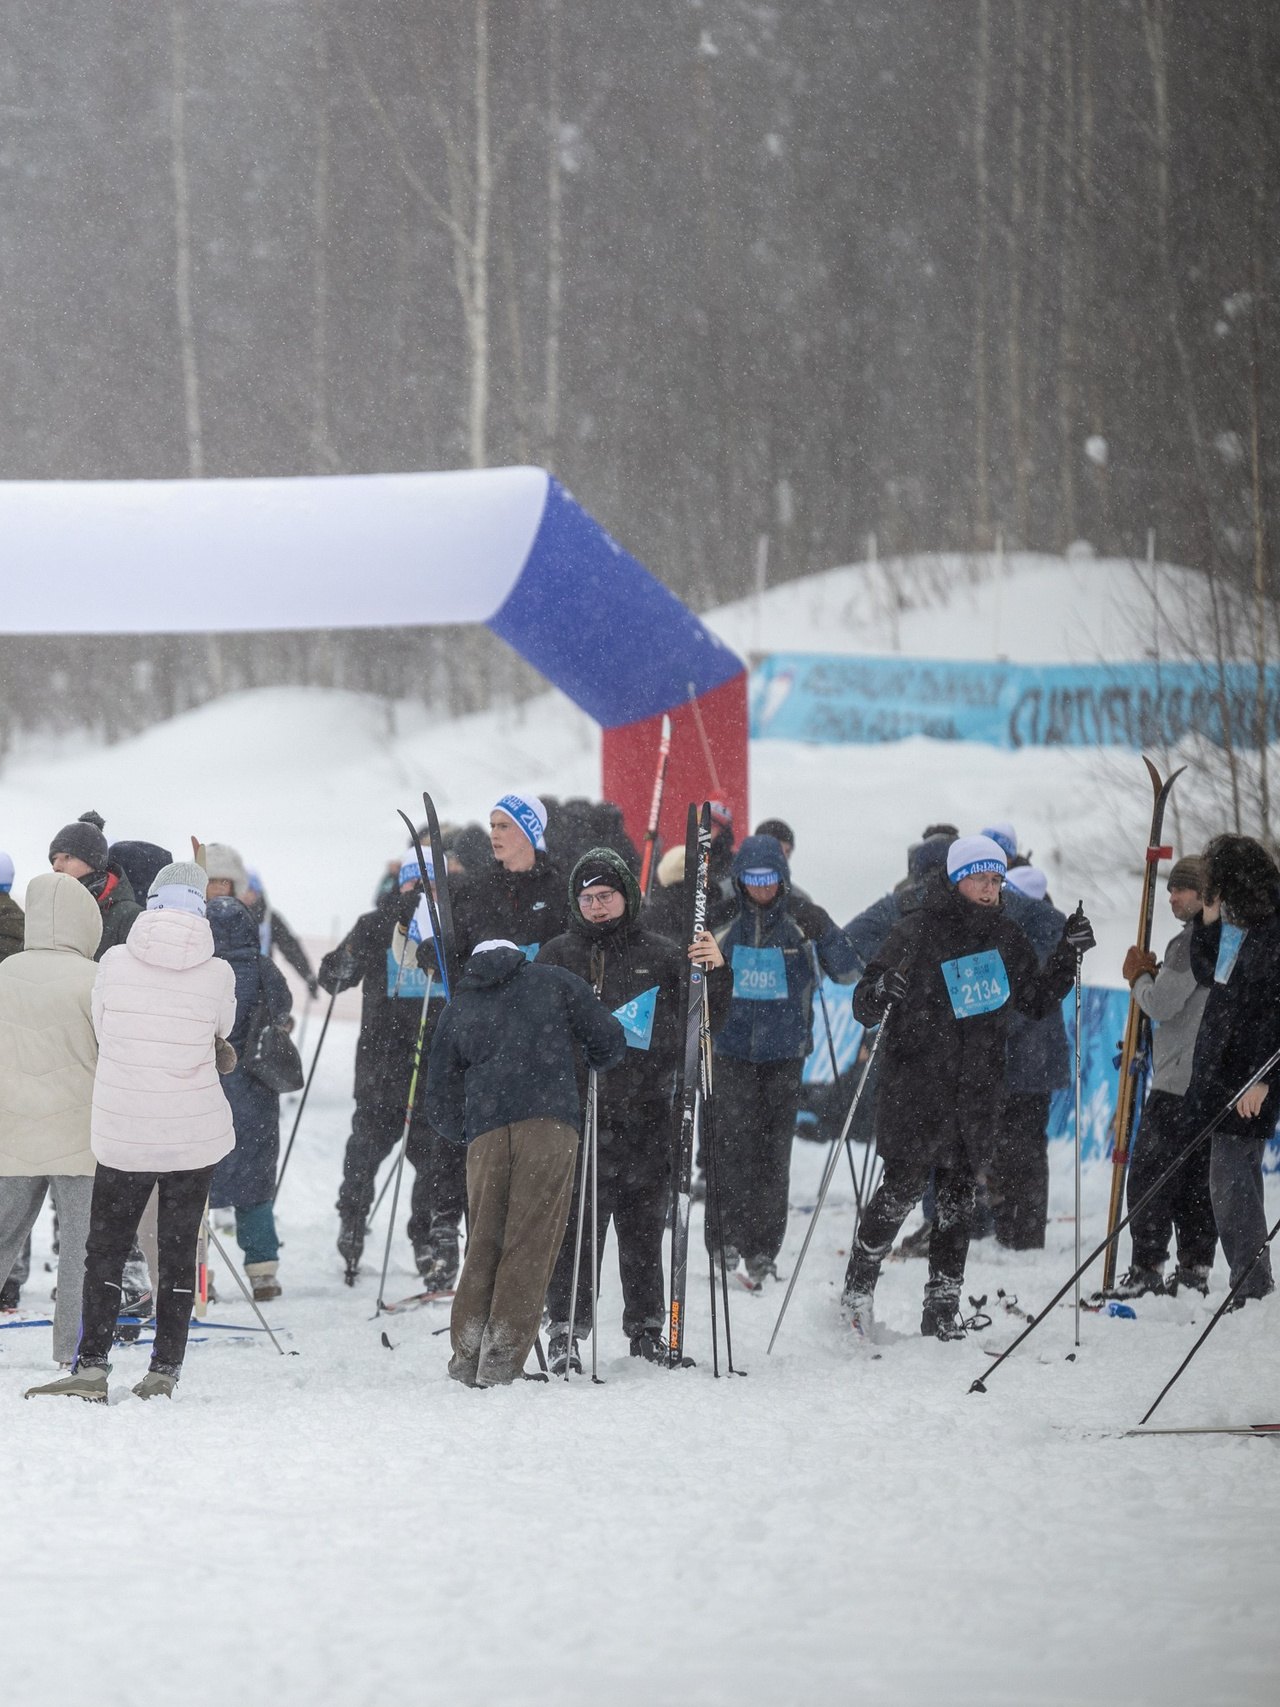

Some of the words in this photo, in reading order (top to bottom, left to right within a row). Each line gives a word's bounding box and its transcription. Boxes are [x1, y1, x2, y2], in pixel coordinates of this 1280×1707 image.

[520, 809, 543, 842] 202
[961, 977, 1001, 1005] 2134
[671, 1301, 680, 1325] COMBI
[670, 1328, 678, 1349] RACE
